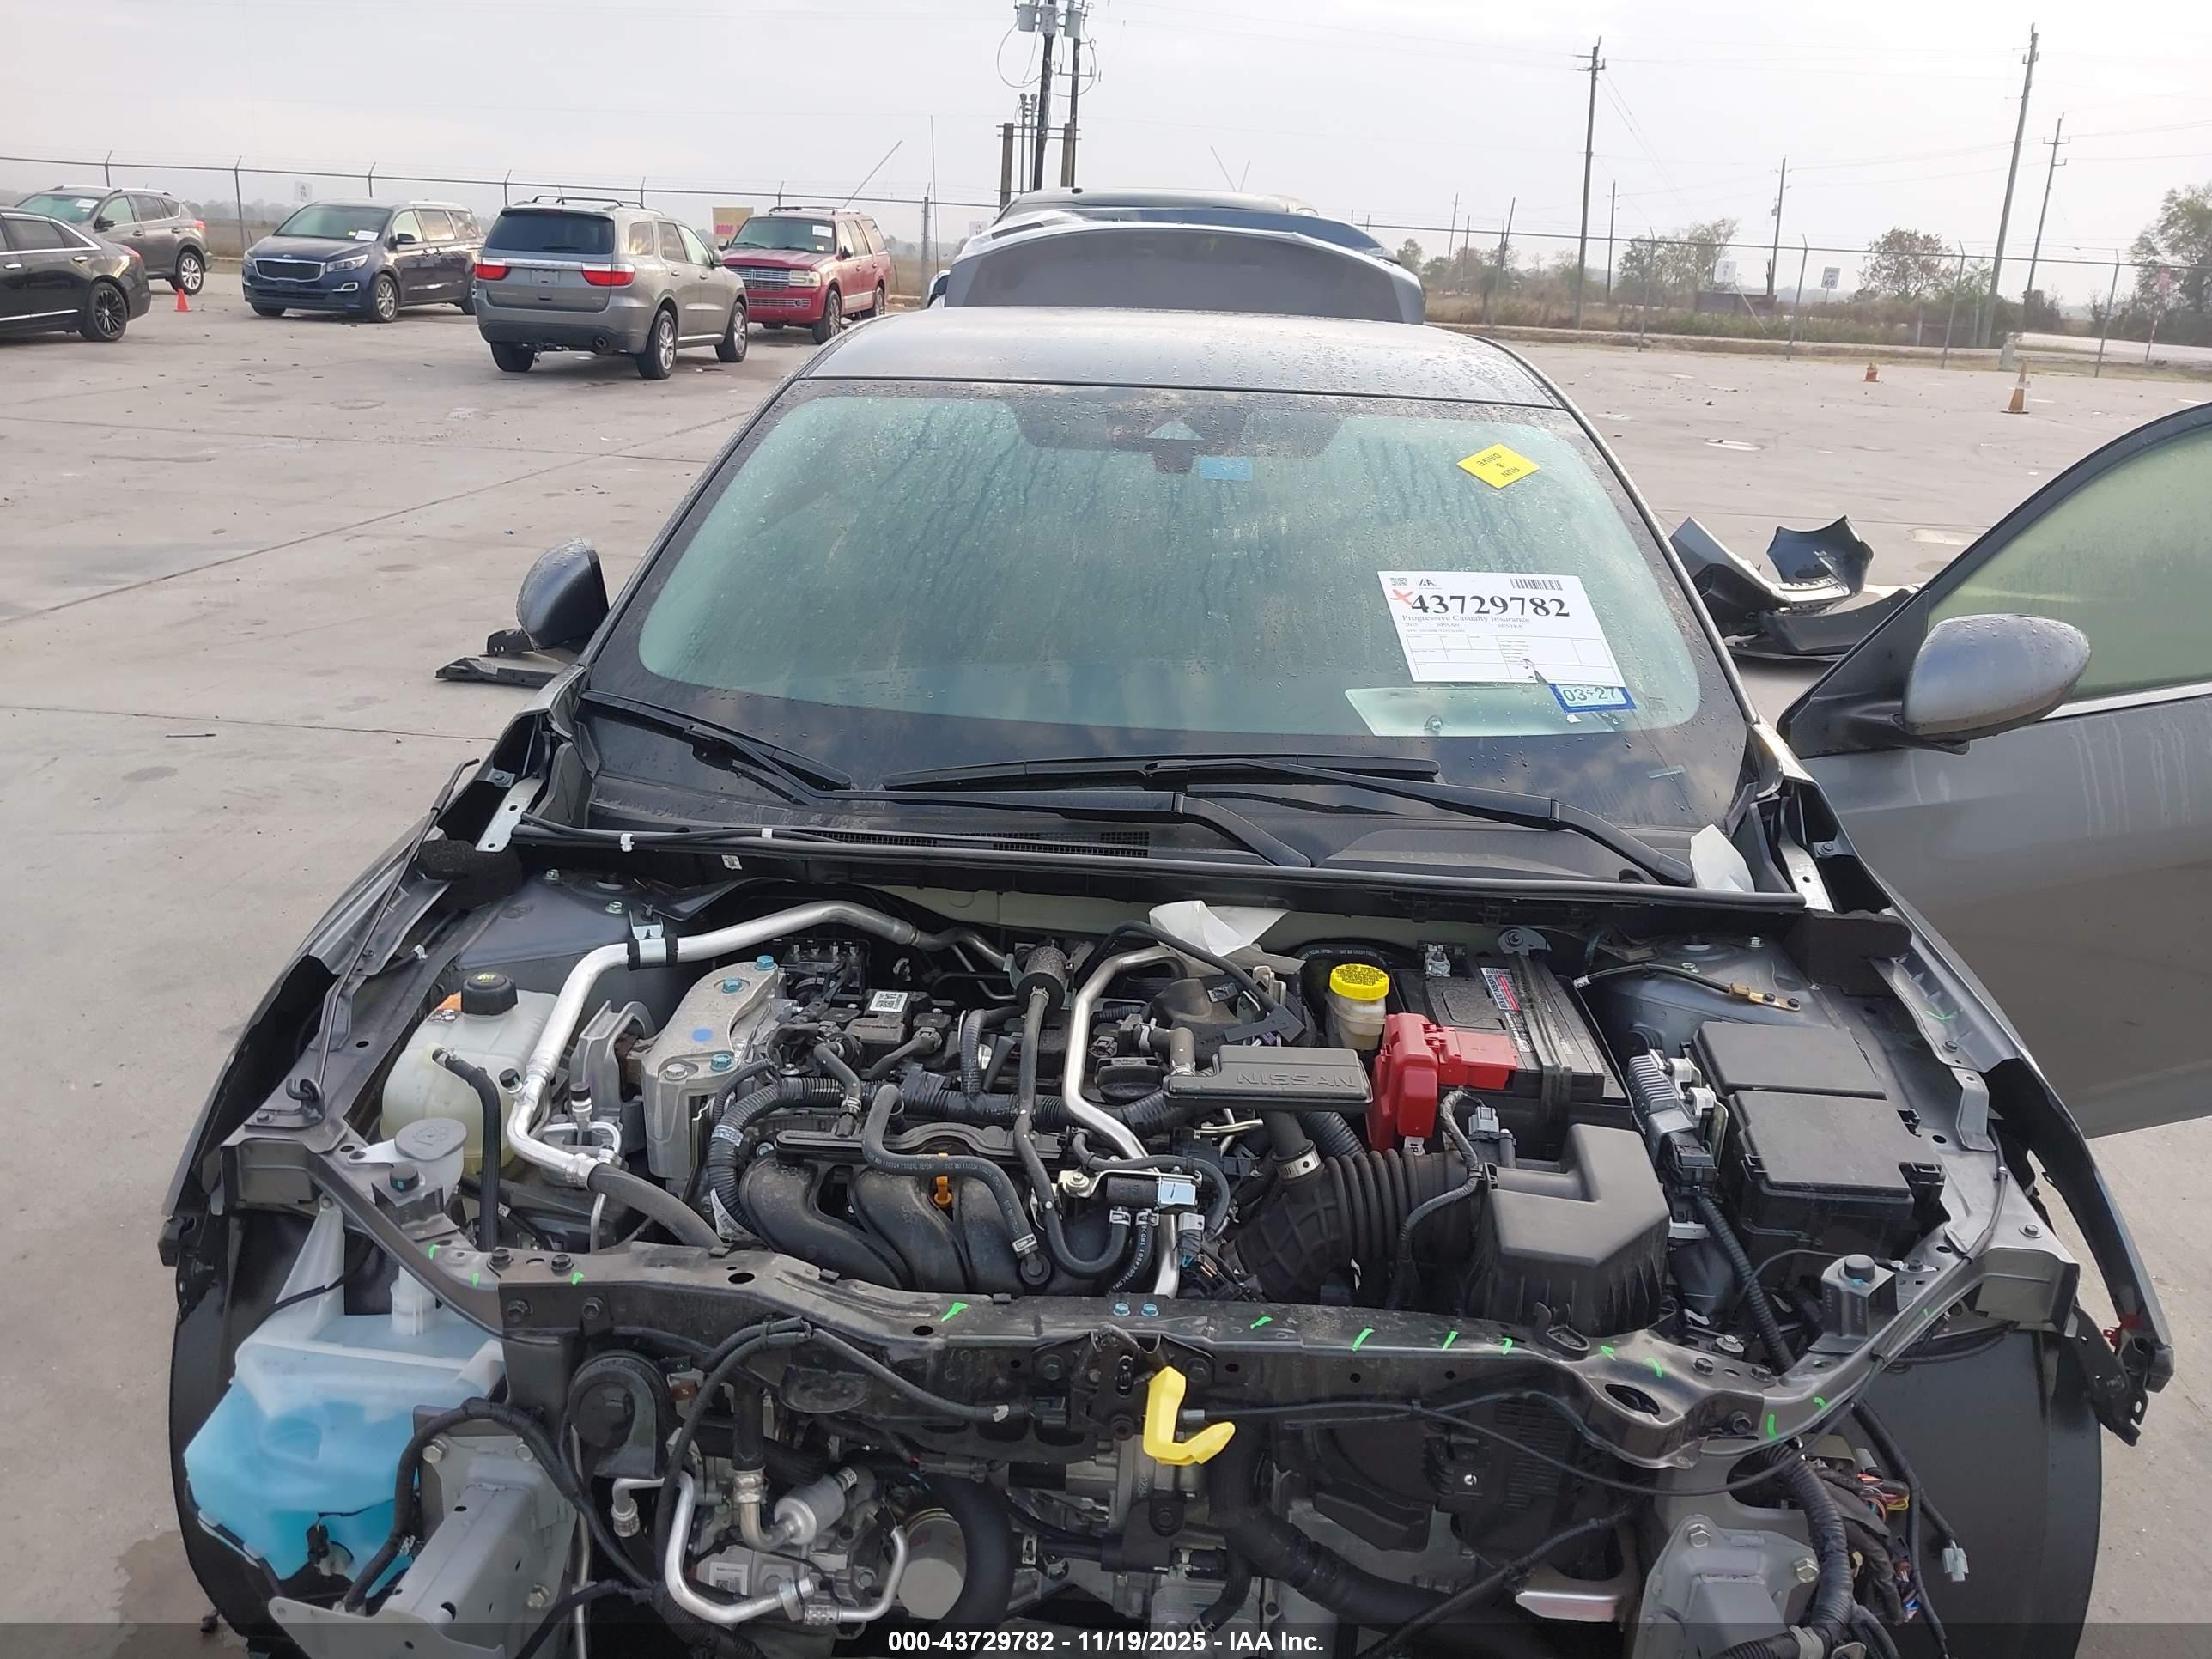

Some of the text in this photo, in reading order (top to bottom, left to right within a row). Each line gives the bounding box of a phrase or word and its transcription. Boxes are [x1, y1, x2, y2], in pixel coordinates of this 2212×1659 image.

[1476, 453, 1502, 466] DRIVE
[1500, 467, 1520, 477] RUN
[1411, 594, 1571, 617] 43729782
[1237, 1072, 1357, 1088] NISSAN
